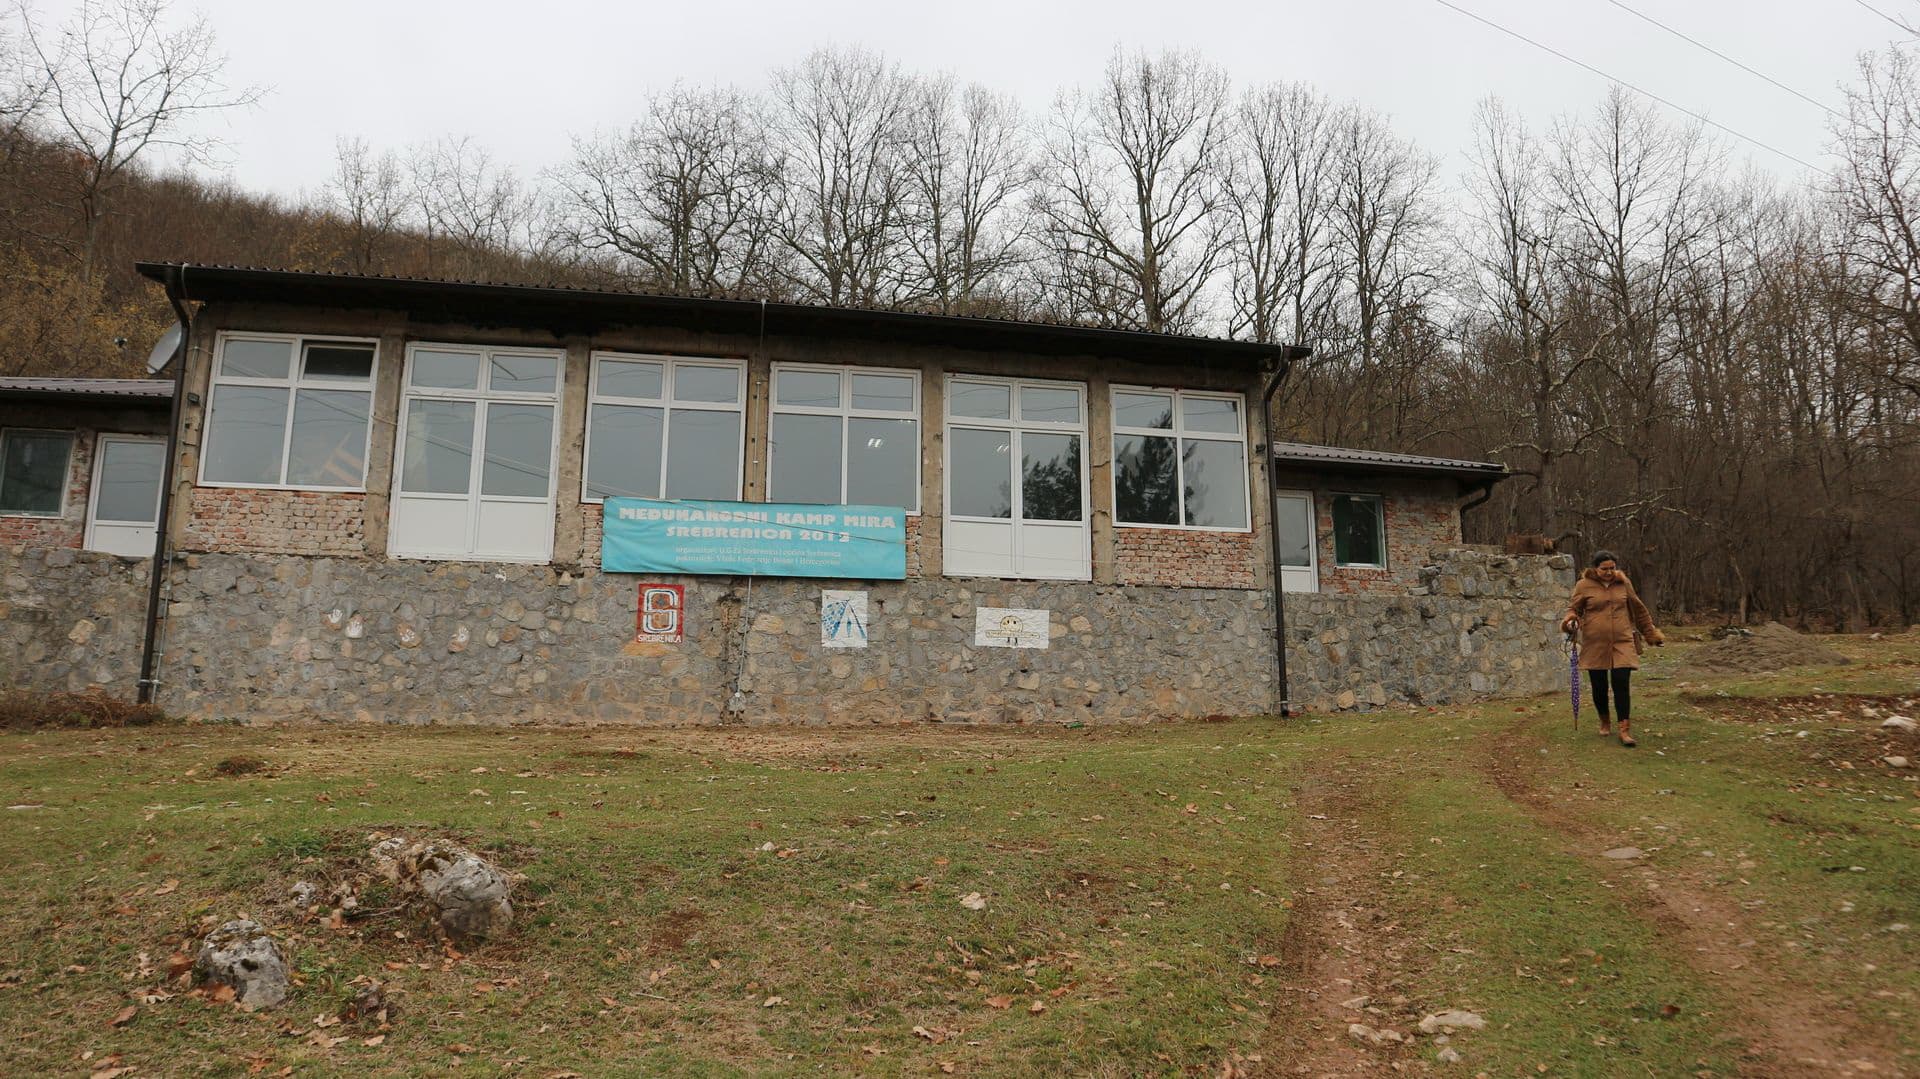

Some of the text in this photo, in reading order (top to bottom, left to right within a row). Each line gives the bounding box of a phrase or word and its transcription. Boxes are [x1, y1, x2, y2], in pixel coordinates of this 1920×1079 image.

[776, 512, 836, 526] KAMP
[844, 515, 896, 528] MIRA
[666, 526, 792, 540] SREBRENICA
